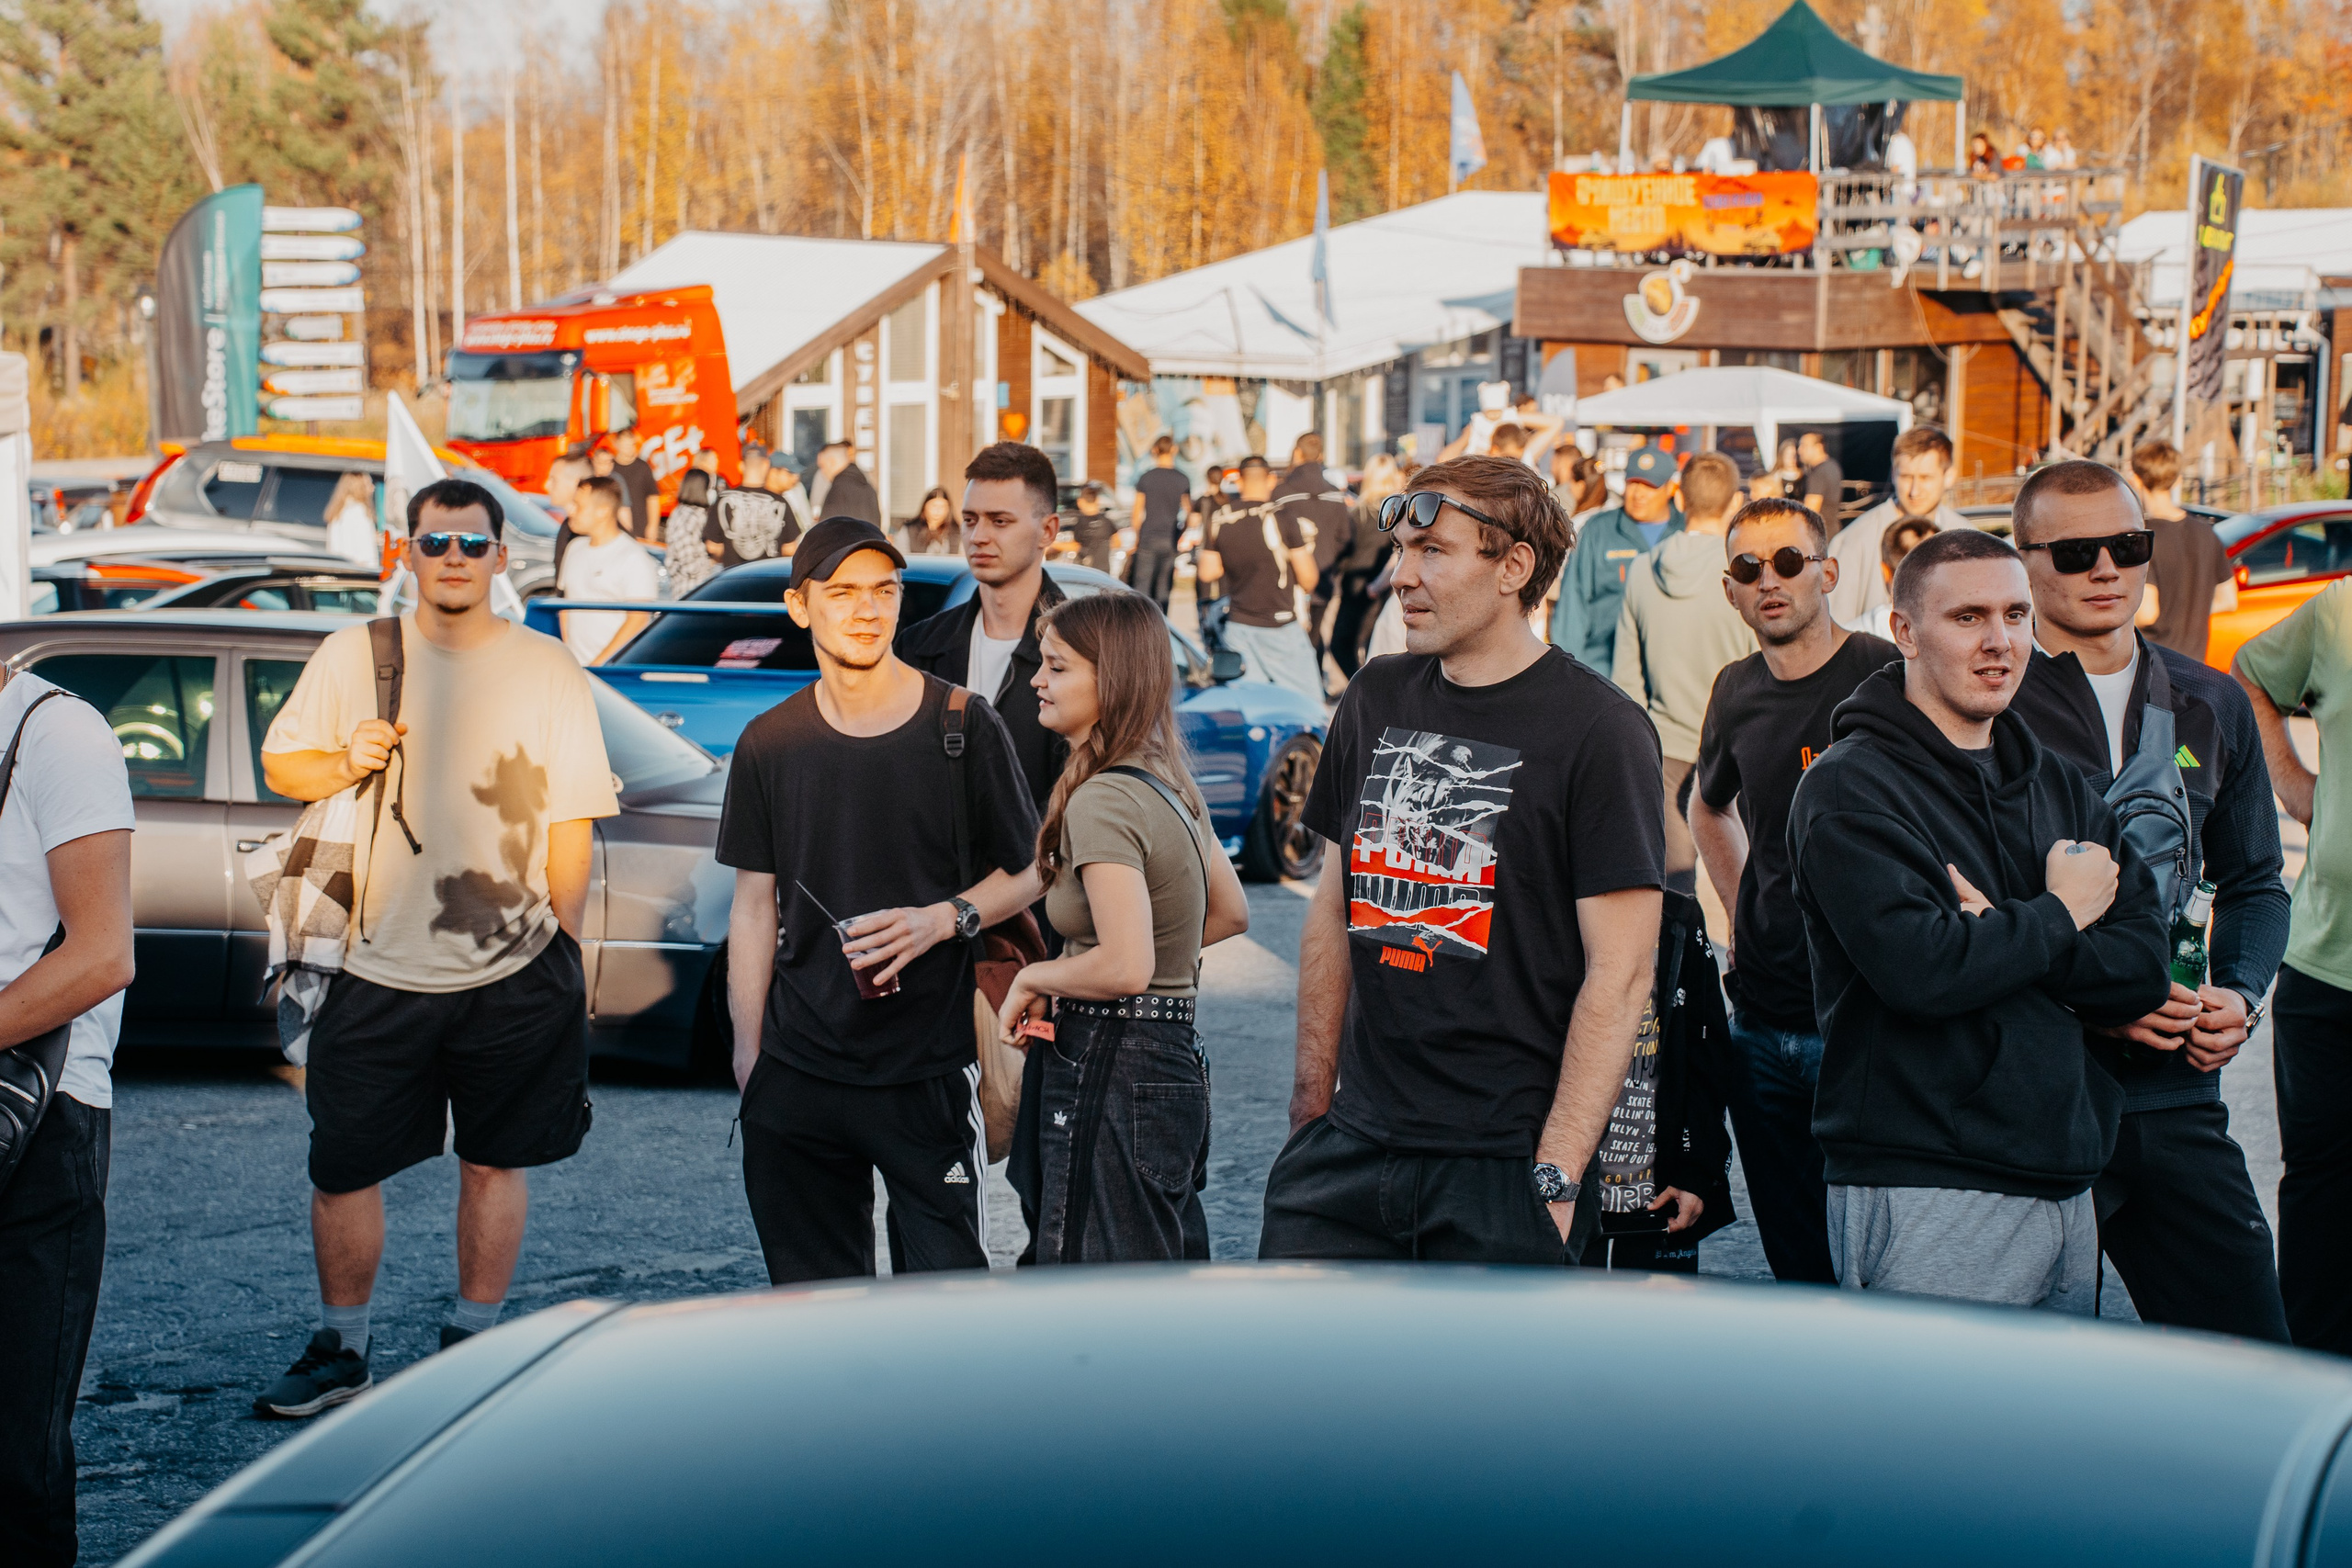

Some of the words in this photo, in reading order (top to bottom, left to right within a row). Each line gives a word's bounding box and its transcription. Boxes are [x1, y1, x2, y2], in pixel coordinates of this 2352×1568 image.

[1379, 945, 1427, 973] PUMA
[1626, 1095, 1652, 1108] SKATE
[1612, 1106, 1644, 1120] OLLIN'
[1609, 1122, 1639, 1136] RKLYN
[1610, 1139, 1641, 1153] SKATE
[1629, 1154, 1650, 1164] OUT
